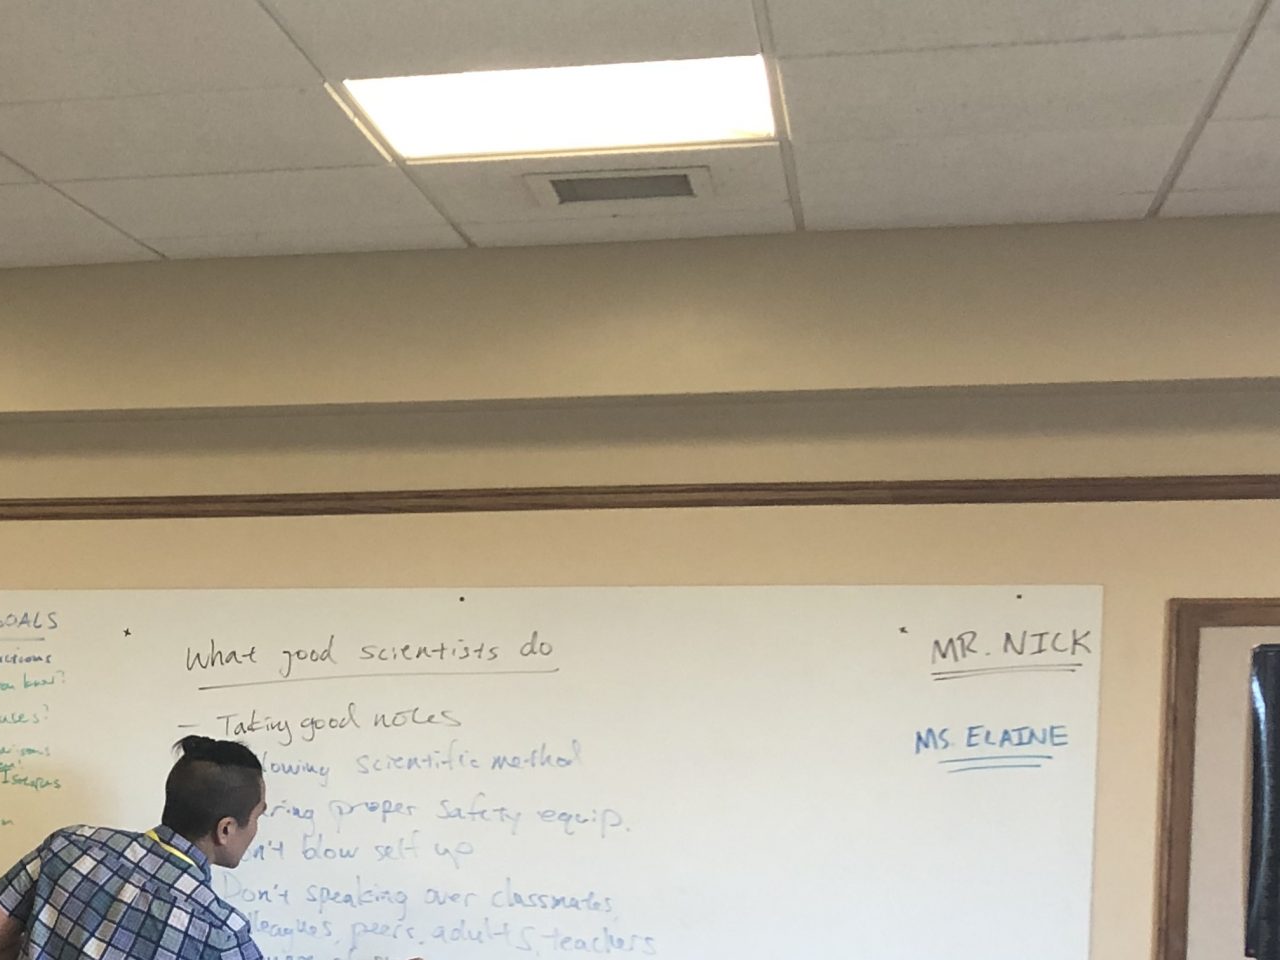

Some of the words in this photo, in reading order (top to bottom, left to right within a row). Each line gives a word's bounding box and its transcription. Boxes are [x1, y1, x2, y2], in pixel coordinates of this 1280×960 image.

[186, 638, 257, 671] What
[279, 634, 337, 678] good
[359, 637, 501, 661] scientists
[519, 630, 553, 656] do
[931, 630, 991, 665] MR.
[1003, 628, 1091, 656] NICK
[216, 709, 293, 747] Taking
[300, 702, 361, 743] good
[374, 706, 462, 728] notes
[966, 725, 1068, 748] ELAINE
[302, 833, 360, 861] blow
[434, 841, 475, 870] up
[223, 872, 290, 905] Don't
[306, 876, 408, 921] speaking
[425, 888, 477, 908] over
